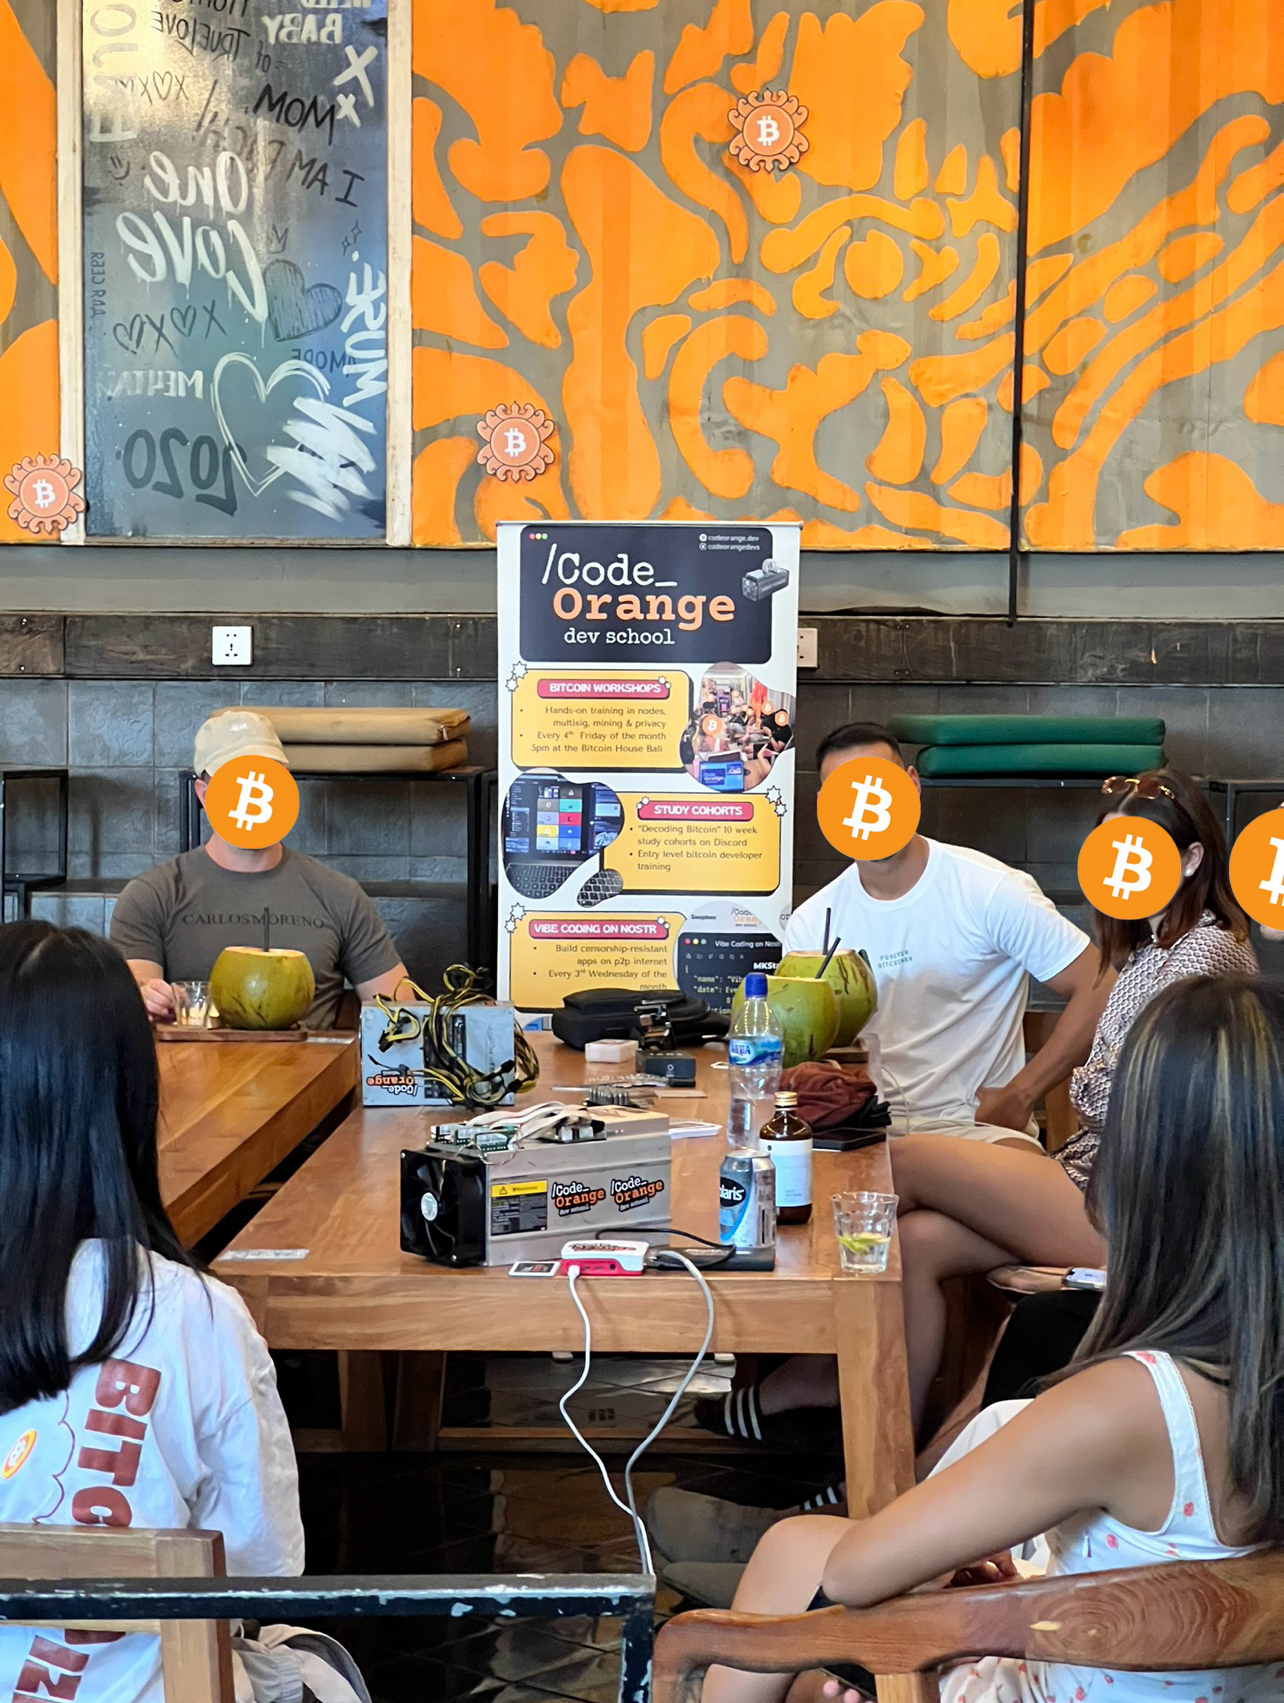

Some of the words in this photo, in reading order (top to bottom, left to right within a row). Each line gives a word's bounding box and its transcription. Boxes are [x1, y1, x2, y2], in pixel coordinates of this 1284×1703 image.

[708, 535, 759, 543] codeorange.dev
[553, 587, 735, 631] Orange
[564, 628, 600, 644] dev
[606, 628, 675, 645] school
[549, 682, 591, 693] BITCOIN
[593, 683, 661, 693] WORKSHOPS
[545, 706, 587, 715] Hands-on
[591, 707, 623, 716] training
[627, 707, 635, 715] in
[593, 719, 622, 729] mining
[626, 719, 632, 727] &
[635, 720, 666, 729] privacy
[537, 731, 560, 741] Every
[564, 731, 574, 740] 4th
[580, 732, 606, 741] Friday
[610, 732, 618, 740] of
[622, 732, 636, 740] the
[639, 732, 666, 740] month
[531, 744, 550, 753] 5pm
[553, 744, 561, 752] at
[564, 744, 578, 752] the
[581, 744, 612, 752] Bitcoin
[615, 745, 643, 753] House
[646, 745, 663, 753] Bali
[654, 805, 689, 815] STUDY
[691, 806, 743, 815] COHORTS
[736, 826, 757, 834] week
[638, 838, 661, 847] study
[664, 838, 696, 846] cohorts
[714, 838, 748, 846] Discord
[638, 850, 660, 859] Entry
[663, 850, 683, 858] level
[686, 850, 717, 858] bitcoin
[719, 851, 763, 860] developer
[637, 862, 671, 872] training
[534, 924, 558, 933] VIBE
[560, 924, 601, 934] CODING
[602, 924, 619, 933] ON
[620, 924, 657, 934] NOSTR
[556, 944, 578, 953] Build
[581, 945, 667, 955] censorship-resistant
[731, 941, 754, 949] Coding
[577, 958, 597, 966] apps
[614, 957, 630, 966] p2p
[633, 957, 667, 965] internet
[549, 970, 572, 979] Every
[574, 969, 586, 978] 3rd
[588, 970, 638, 980] Wednesday
[641, 970, 651, 978] of
[654, 970, 667, 978] the
[616, 1181, 663, 1203] Orange
[556, 1189, 605, 1207] Orange
